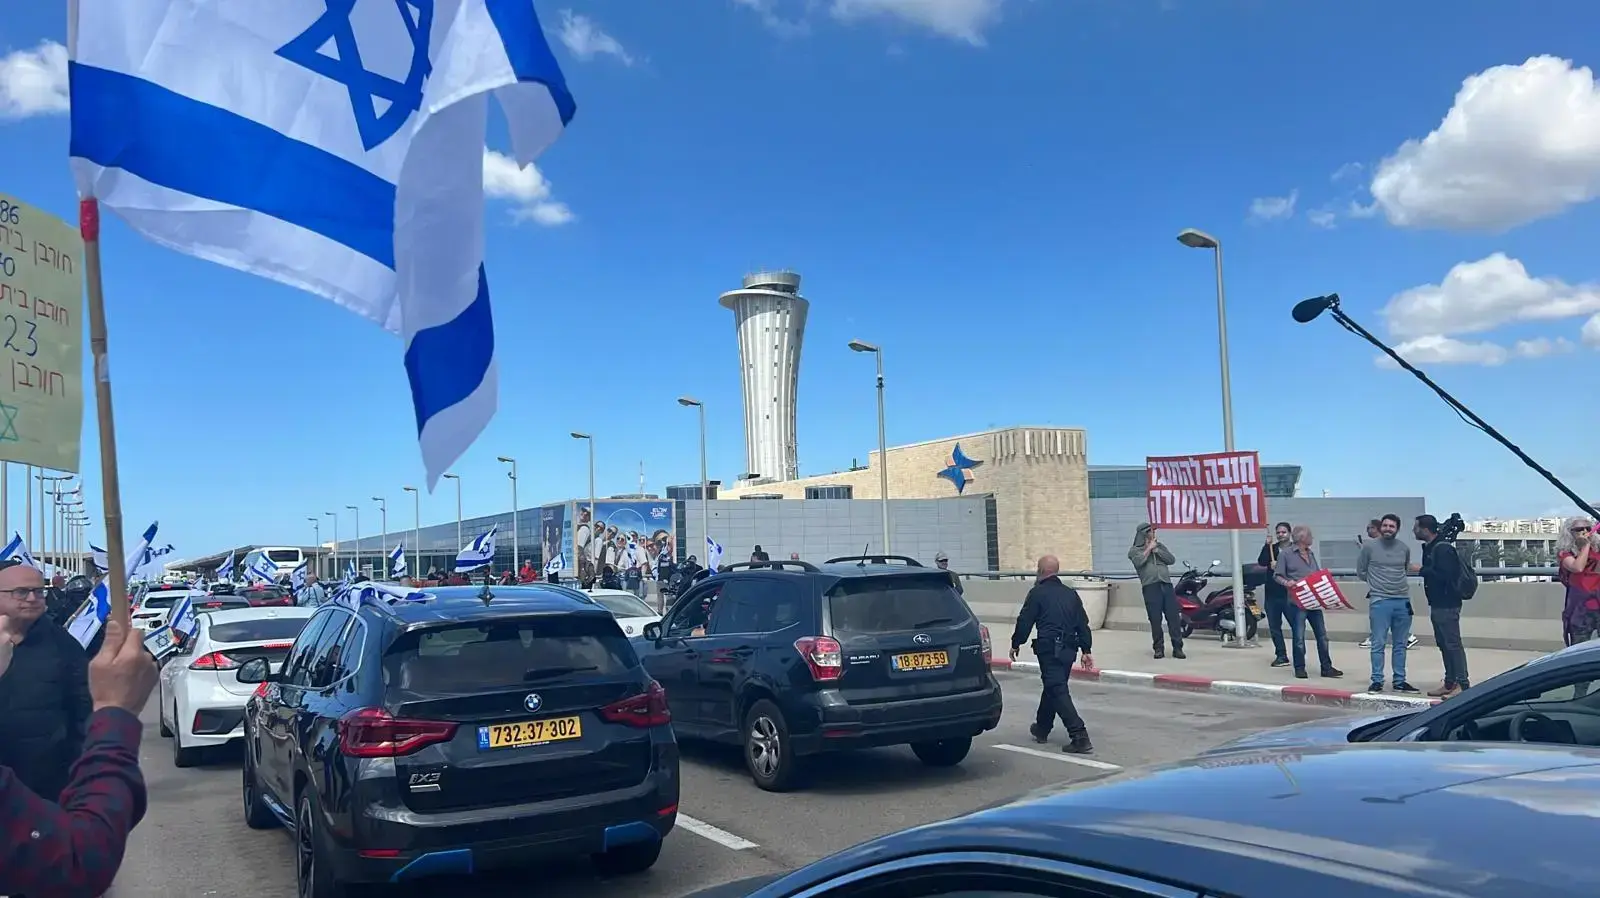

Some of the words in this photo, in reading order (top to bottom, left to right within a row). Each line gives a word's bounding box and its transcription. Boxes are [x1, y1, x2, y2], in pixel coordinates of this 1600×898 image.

[34, 240, 72, 274] חורבן
[33, 296, 70, 327] חורבן
[11, 357, 65, 397] חורבן
[1203, 455, 1256, 486] חובה
[1149, 484, 1259, 526] לדיקטטורה
